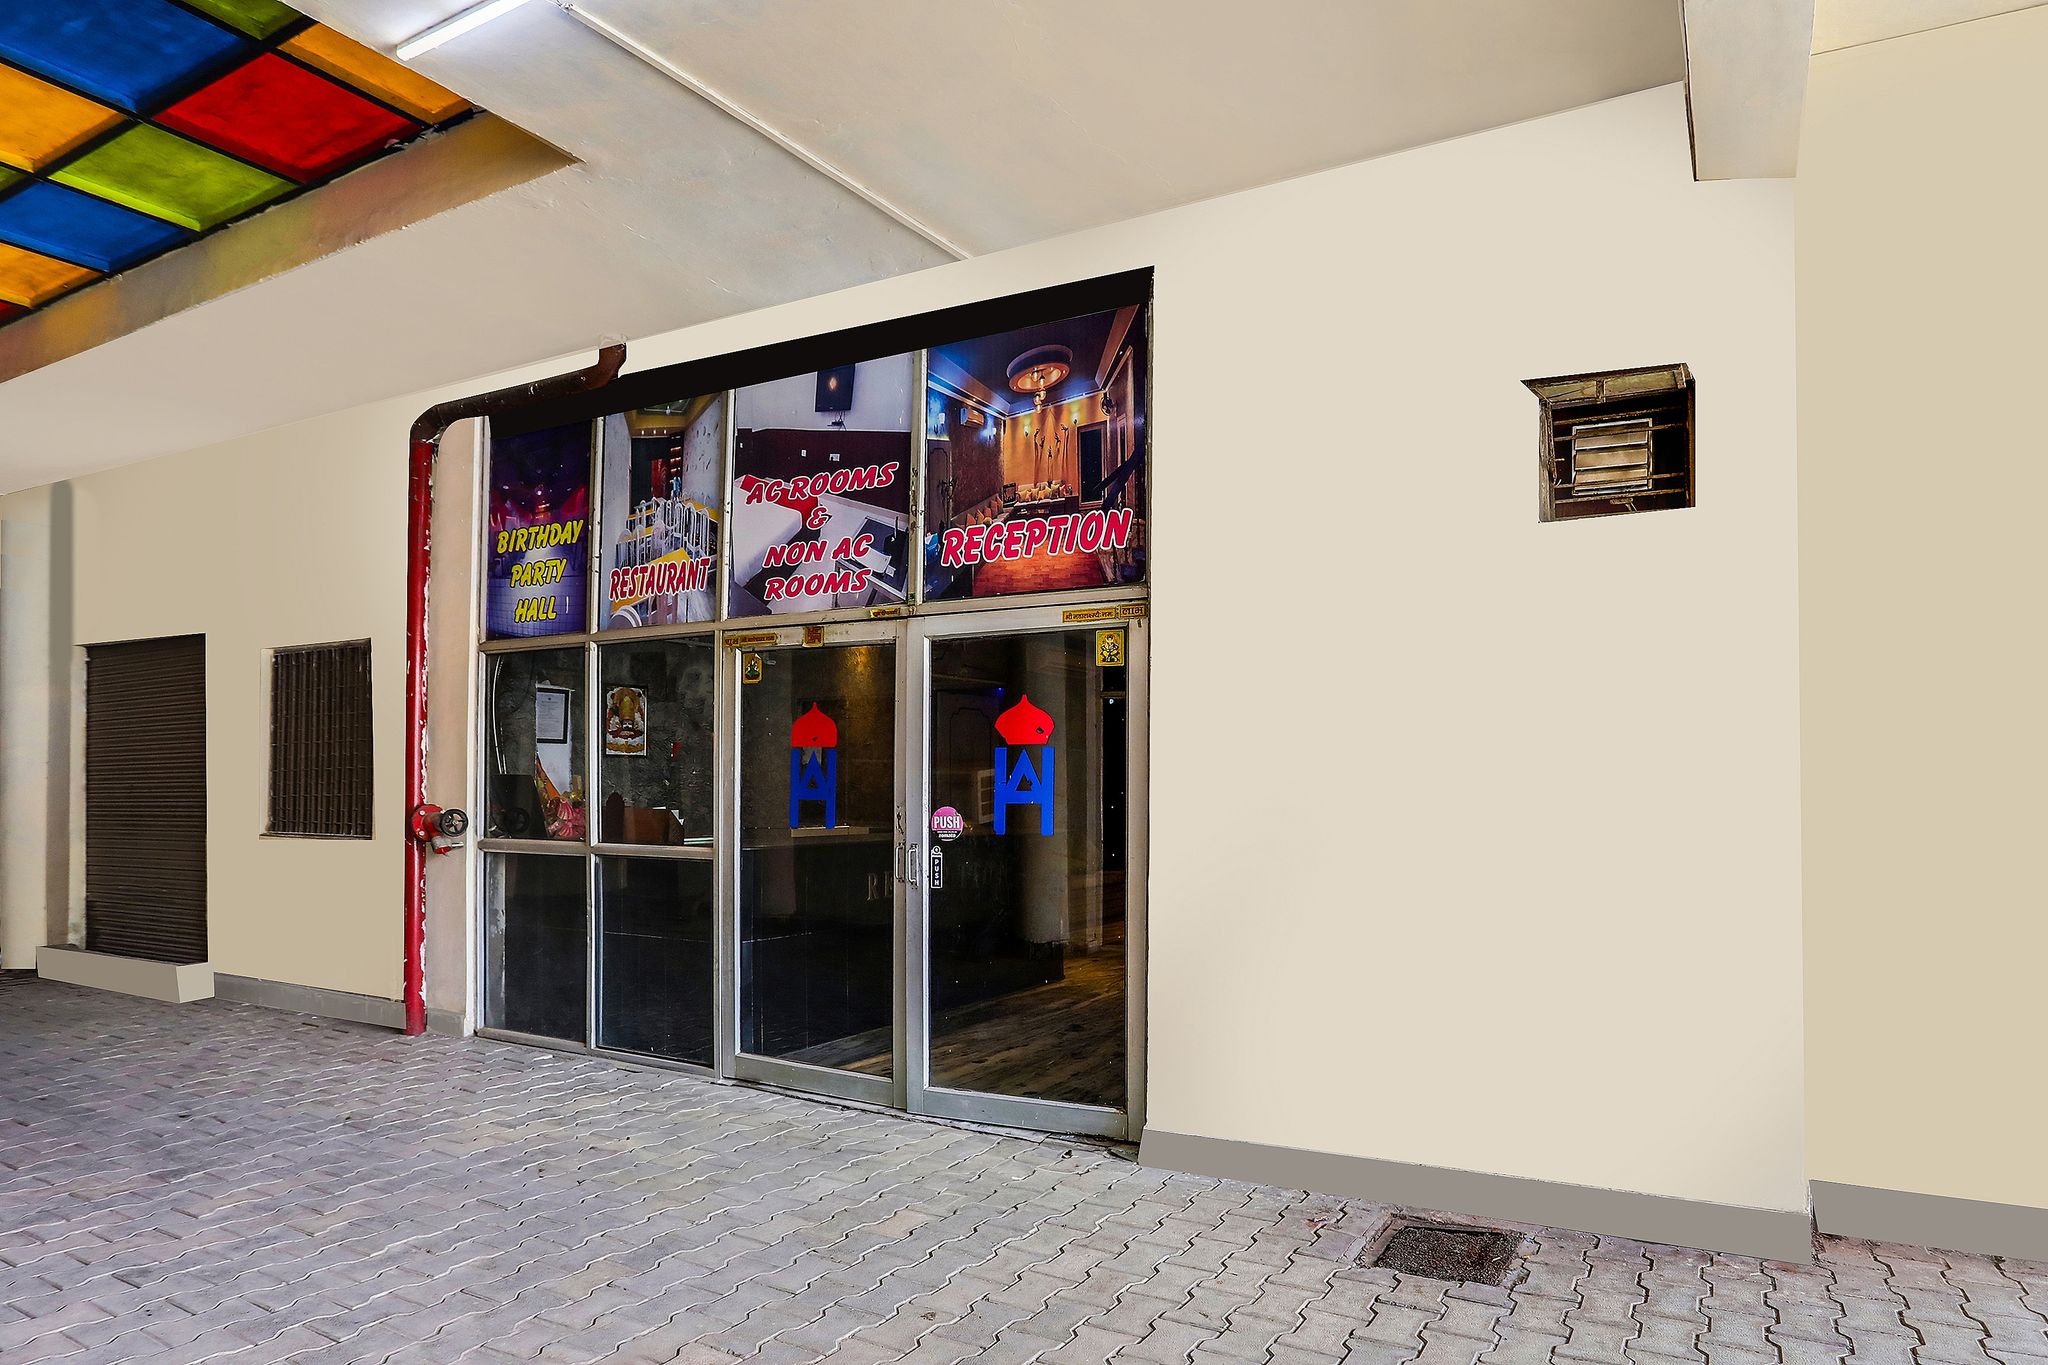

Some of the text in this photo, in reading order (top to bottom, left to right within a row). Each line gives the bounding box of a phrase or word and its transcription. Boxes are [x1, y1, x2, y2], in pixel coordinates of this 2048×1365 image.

[745, 462, 899, 505] AC ROOMS
[806, 507, 828, 531] &
[496, 520, 584, 554] BIRTHDAY
[763, 534, 874, 568] NON AC
[941, 508, 1133, 569] RECEPTION
[510, 558, 567, 588] PARTY
[608, 557, 711, 601] RESTAURANT
[764, 569, 872, 601] ROOMS
[514, 596, 557, 623] HALL
[933, 816, 960, 829] PUSH
